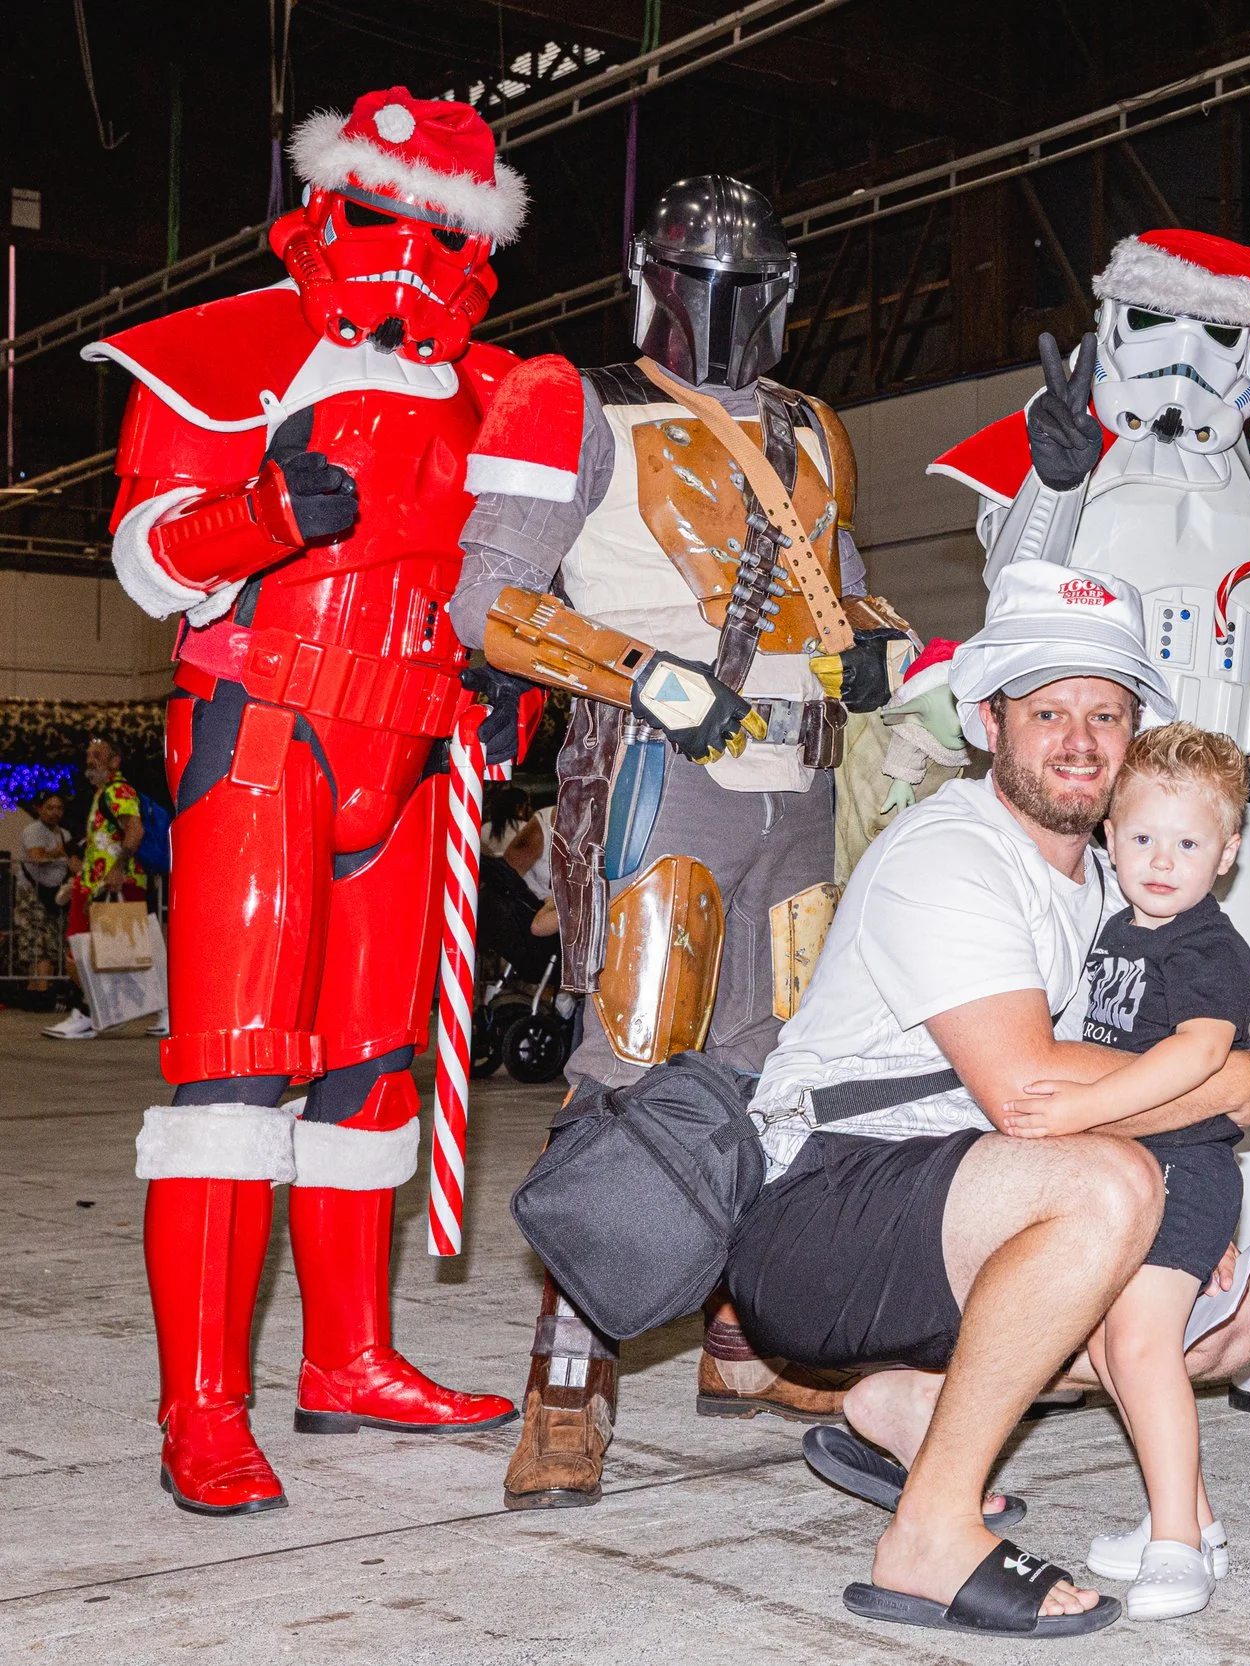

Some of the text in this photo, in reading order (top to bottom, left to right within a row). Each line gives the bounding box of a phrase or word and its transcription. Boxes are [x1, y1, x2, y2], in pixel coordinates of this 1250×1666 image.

[1063, 590, 1104, 598] SHARP
[1066, 597, 1103, 605] STORE
[1083, 1020, 1112, 1044] ROA
